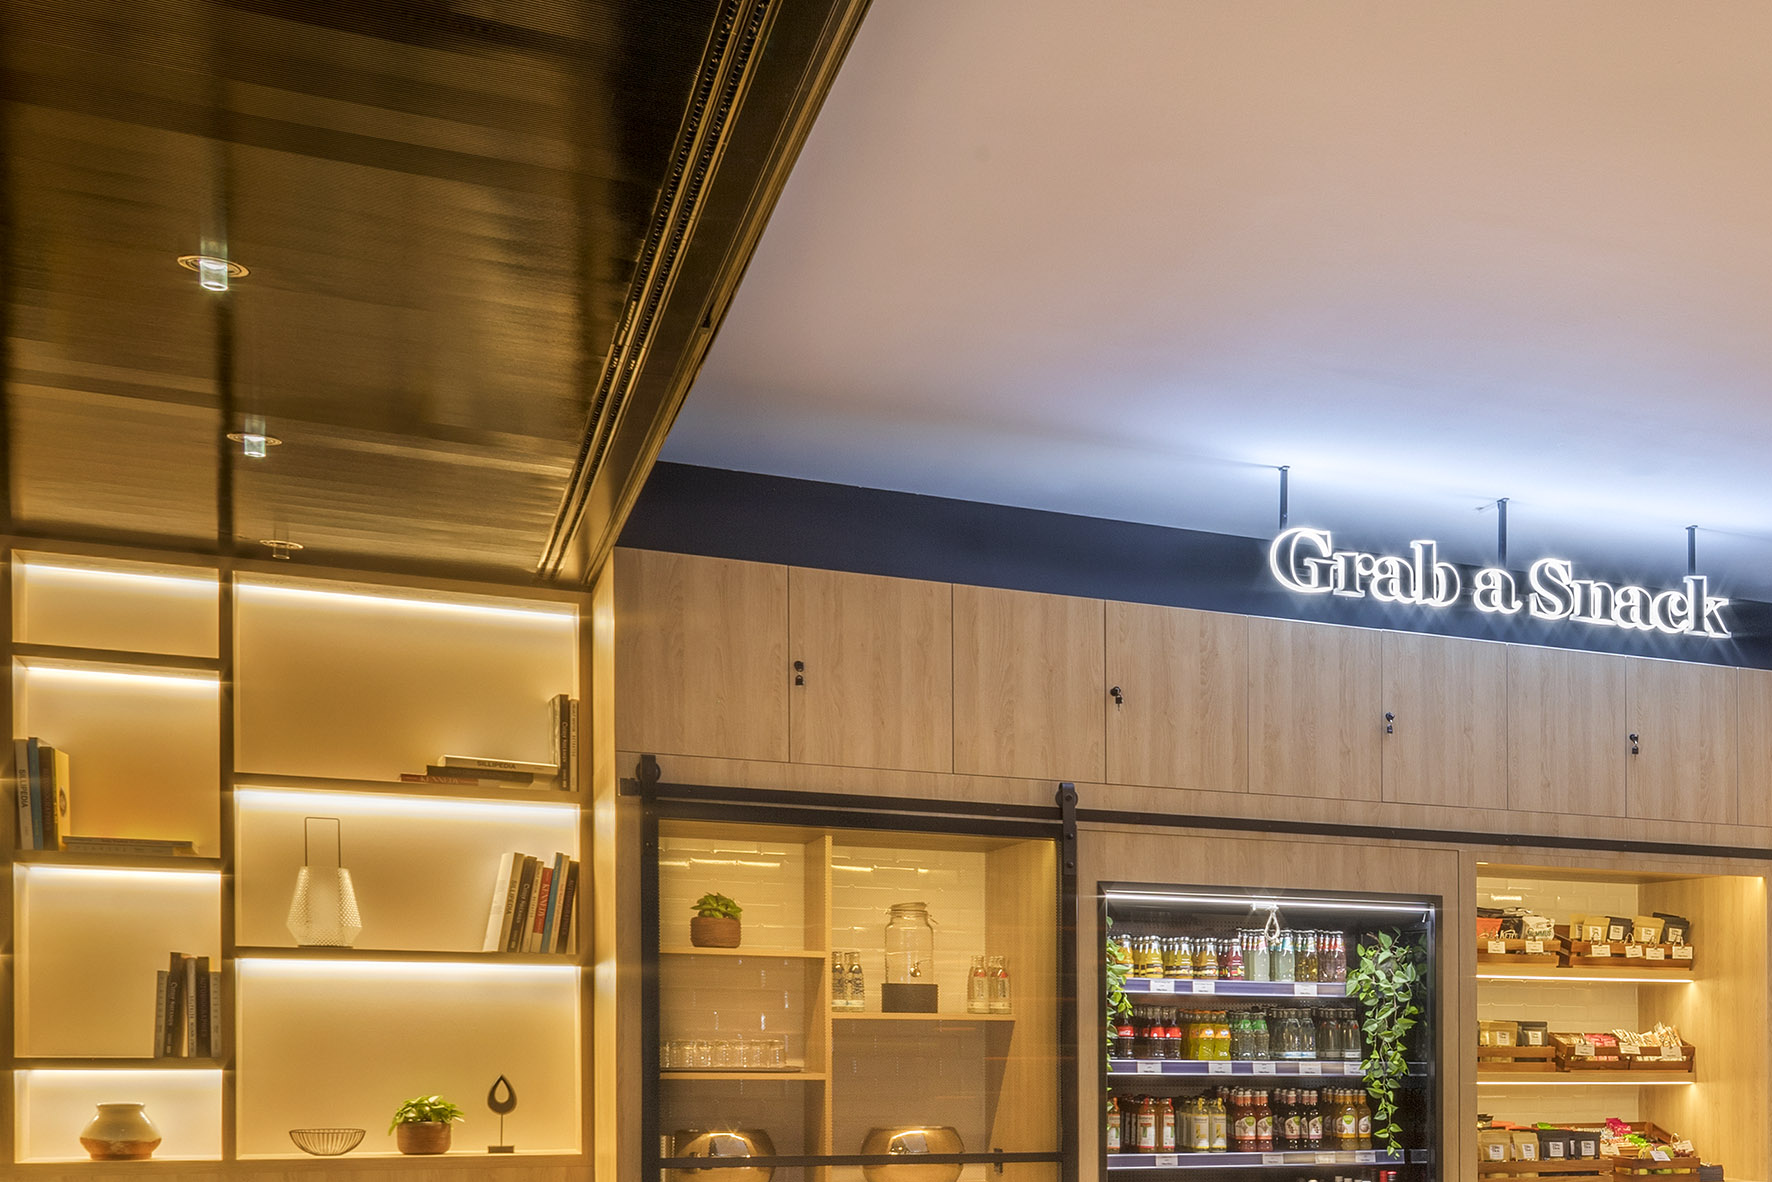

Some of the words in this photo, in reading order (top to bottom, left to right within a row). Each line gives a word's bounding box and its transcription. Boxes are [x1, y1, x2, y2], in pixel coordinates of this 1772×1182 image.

[1269, 526, 1461, 607] Grab
[1473, 566, 1523, 614] a
[1529, 557, 1733, 640] Snack
[18, 769, 28, 808] SILLIPEDIA
[506, 880, 517, 915] SILLIPEDIA
[537, 883, 550, 917] KENNEDY
